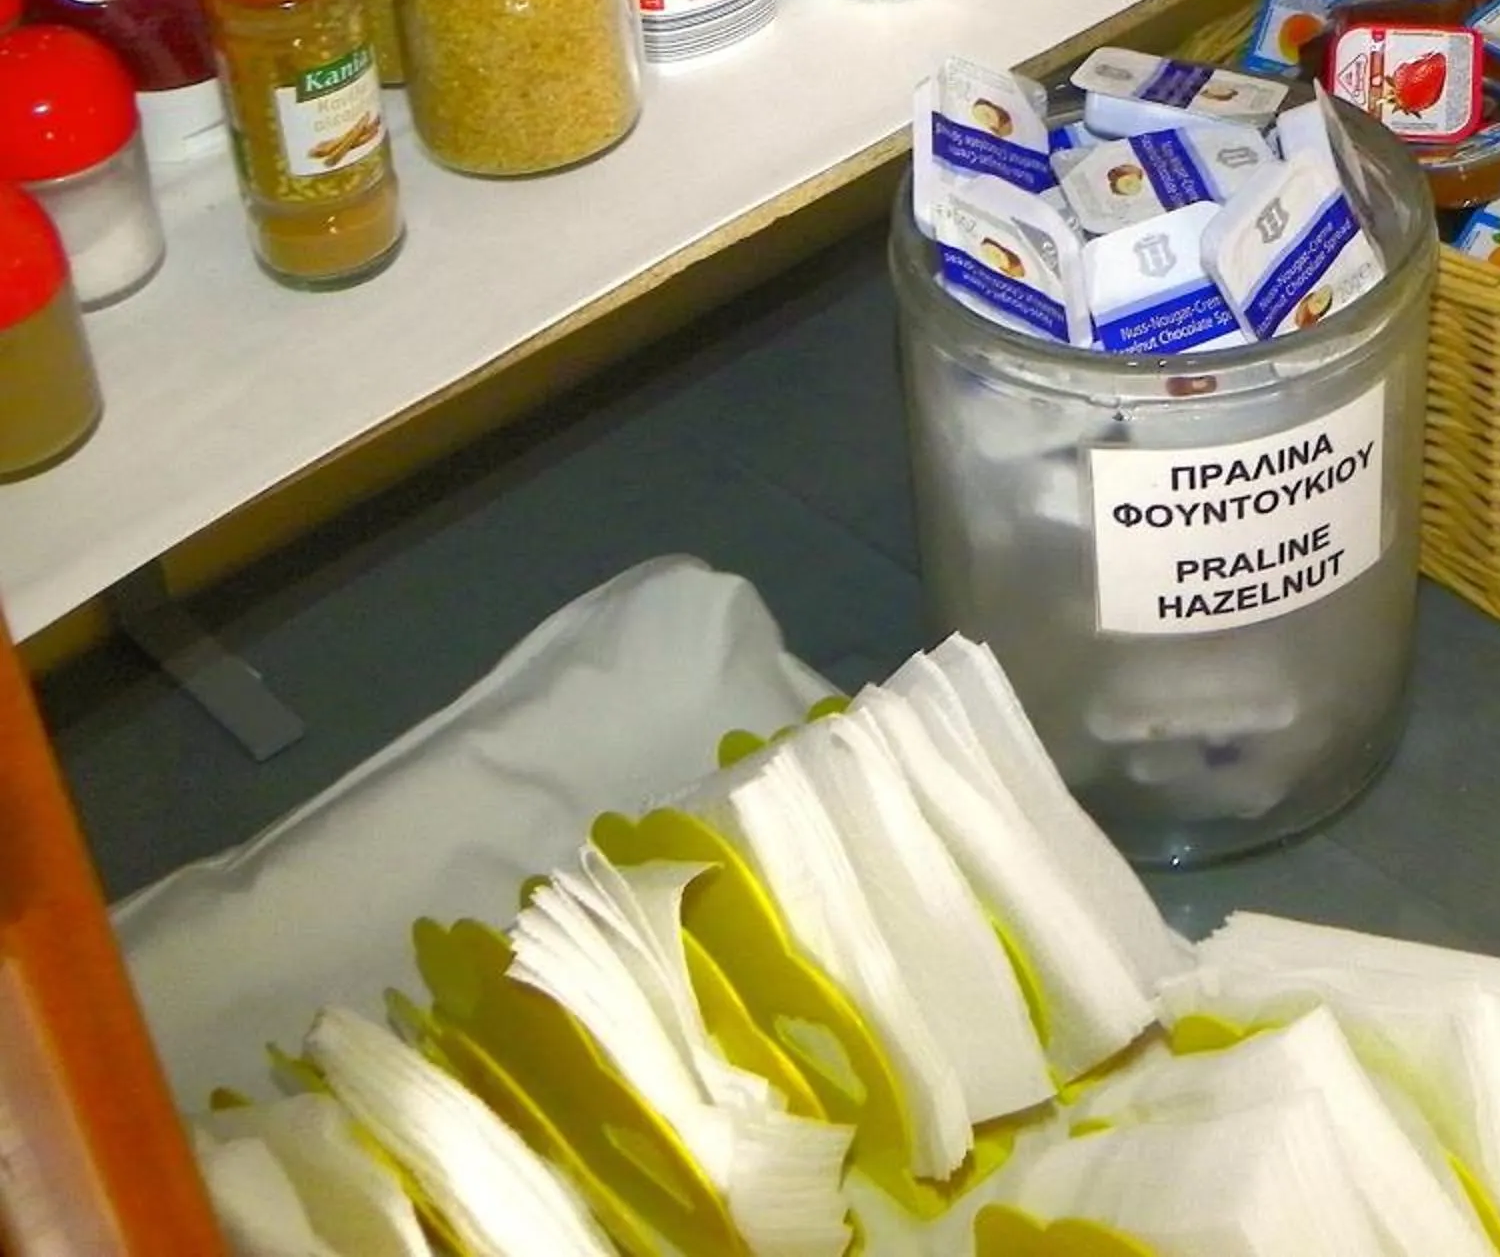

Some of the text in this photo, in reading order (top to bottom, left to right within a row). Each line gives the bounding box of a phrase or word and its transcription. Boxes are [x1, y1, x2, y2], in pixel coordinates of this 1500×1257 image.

[1113, 441, 1375, 528] ΦΟΥΝΤΟΥΚΙΟΥ
[1171, 433, 1334, 492] ΠΡΑΛΙΝΑ
[1158, 549, 1346, 619] HAZELNUT
[1176, 523, 1331, 584] PRALINE
